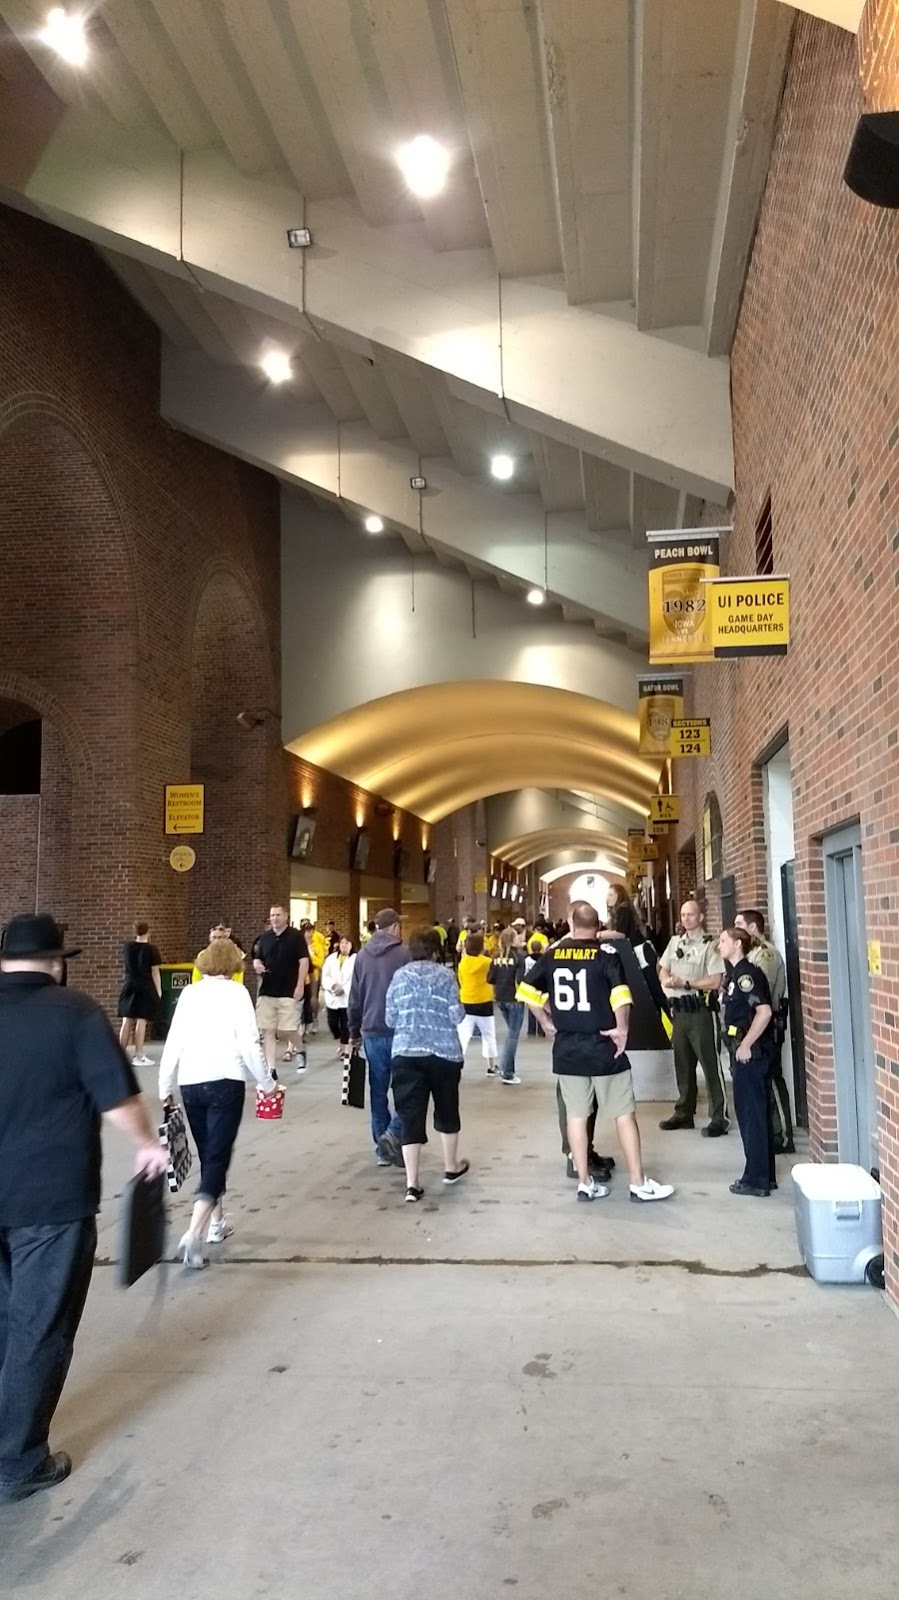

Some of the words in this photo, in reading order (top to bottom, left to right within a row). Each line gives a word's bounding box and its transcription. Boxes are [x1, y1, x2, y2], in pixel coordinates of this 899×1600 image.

[654, 546, 685, 559] PEACH
[687, 545, 713, 556] BOWL
[718, 595, 732, 608] UI
[736, 592, 784, 607] POLICE
[663, 599, 706, 613] 1982
[728, 614, 754, 623] GAME
[756, 613, 774, 622] DAY
[674, 619, 695, 629] IOWA
[718, 623, 784, 634] HEADQUARTERS
[673, 719, 706, 727] SECTIONS
[680, 729, 701, 739] 123
[680, 743, 701, 754] 124
[553, 948, 598, 960] BANWART
[552, 967, 591, 1012] 61
